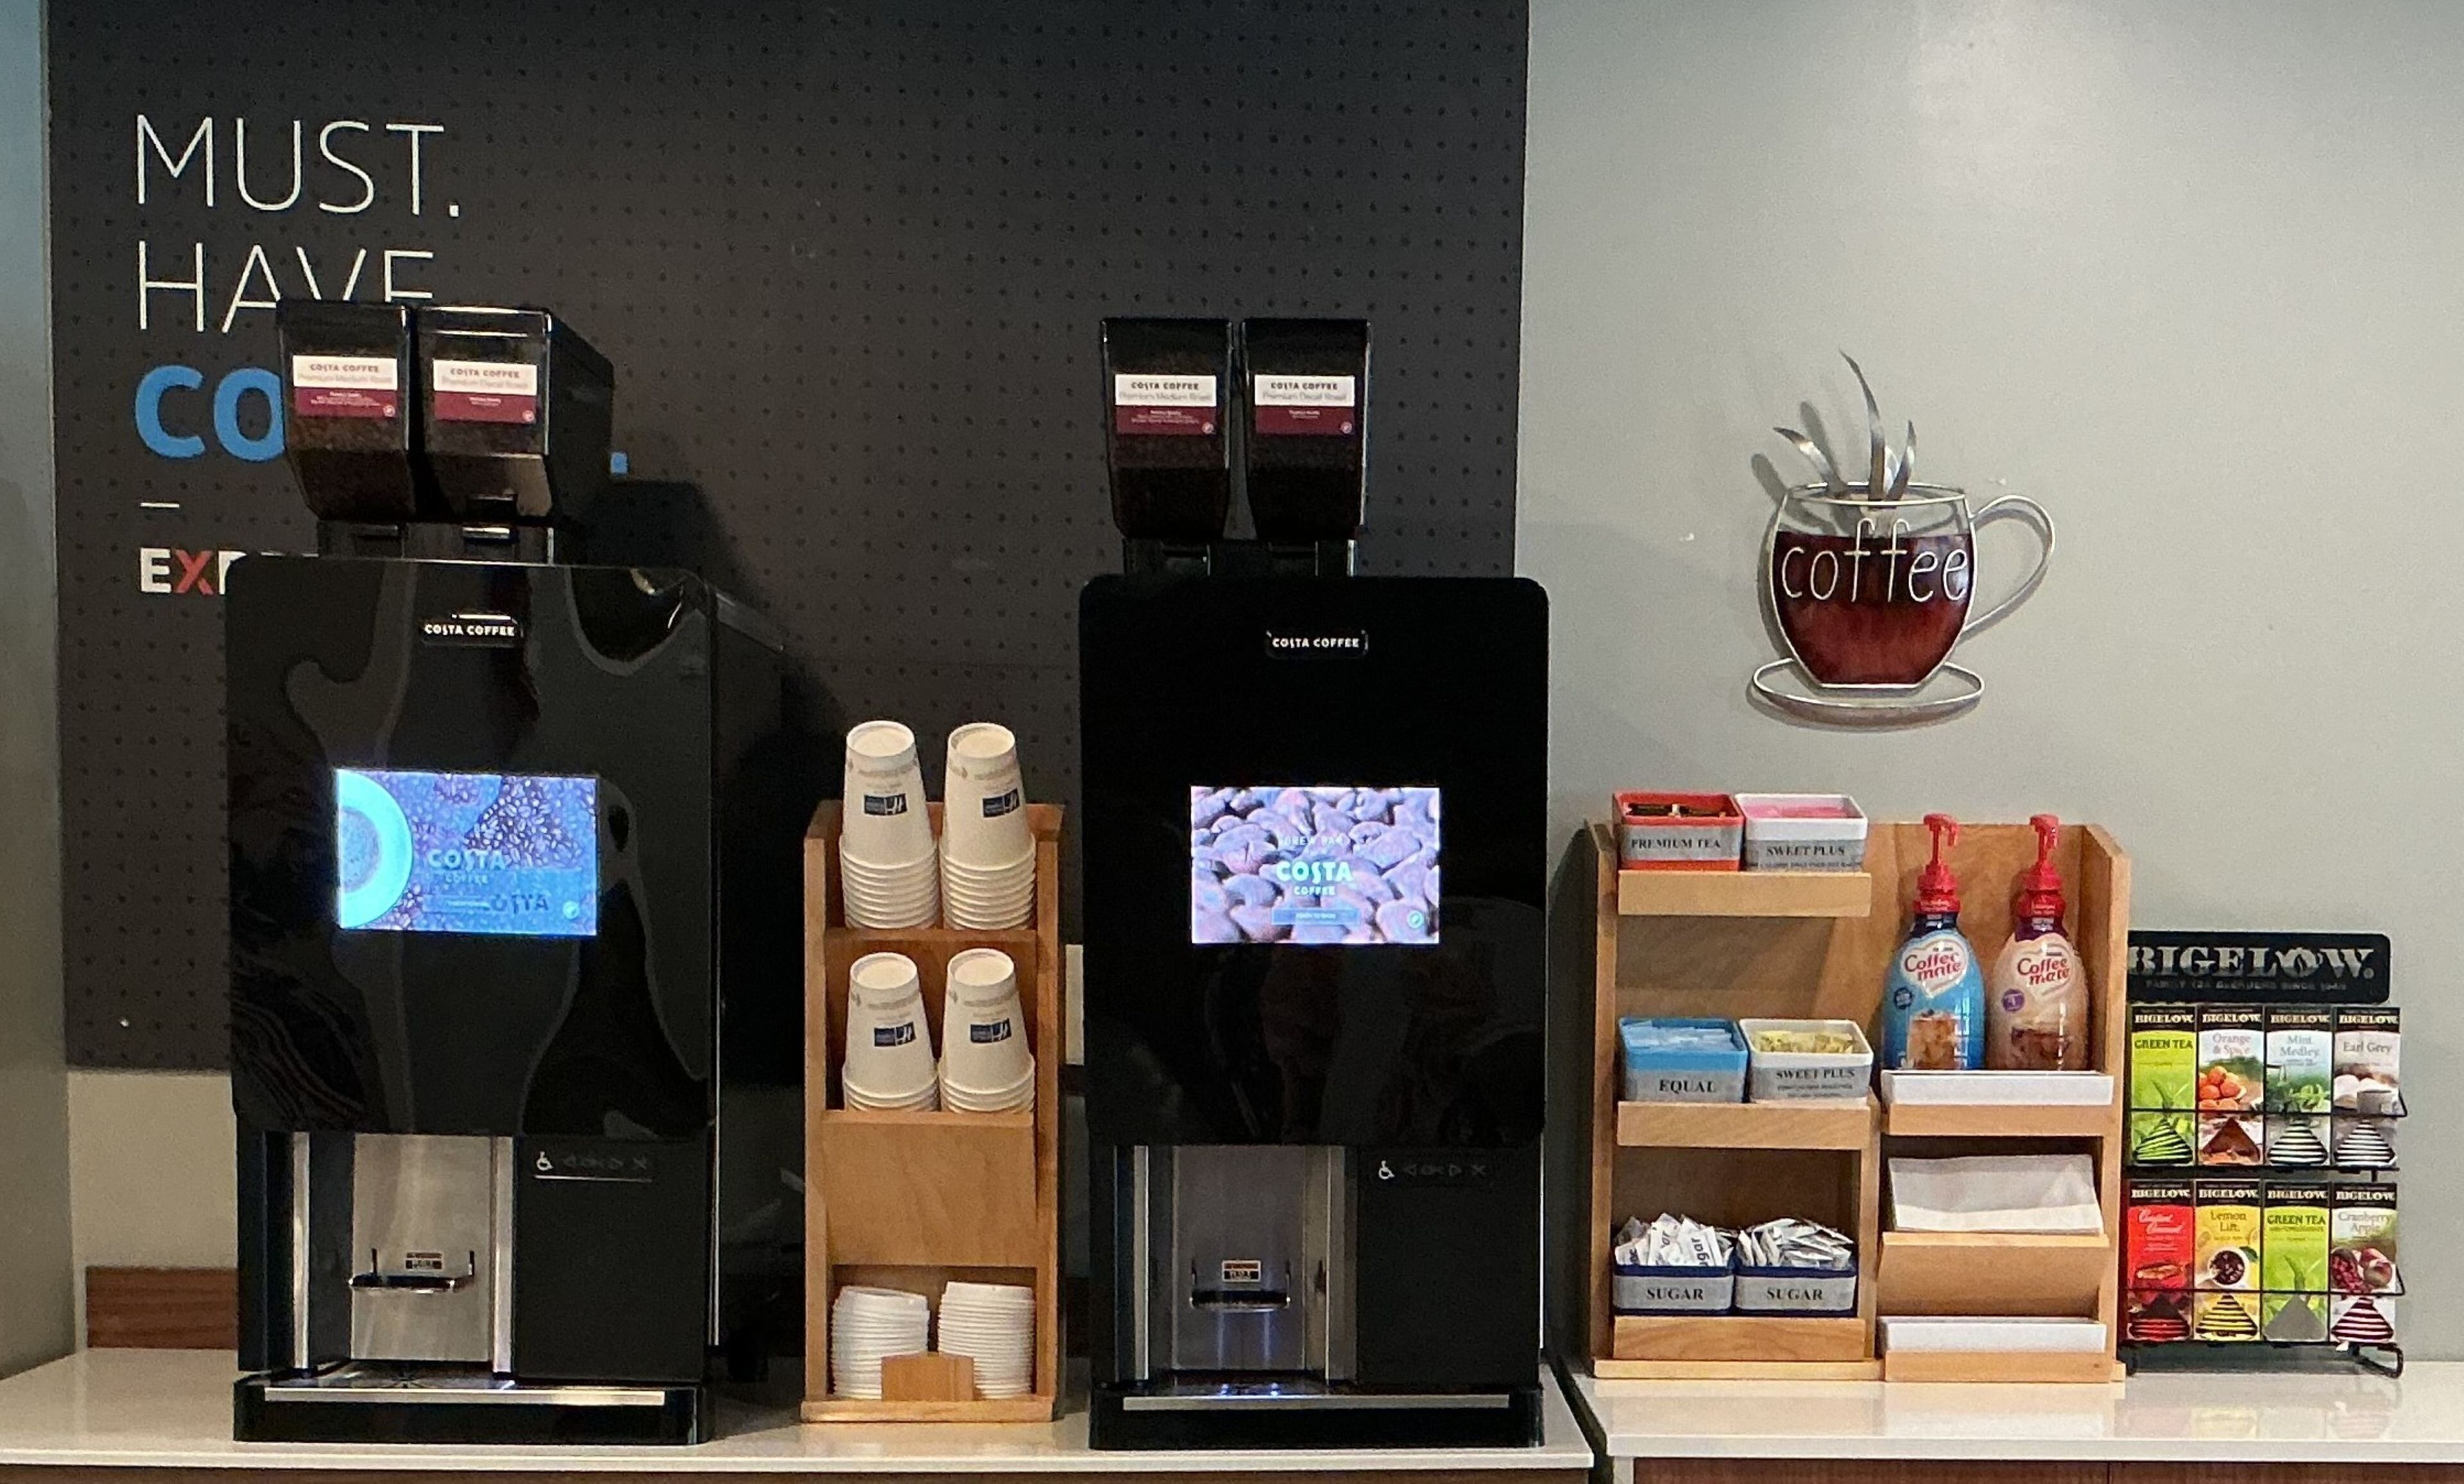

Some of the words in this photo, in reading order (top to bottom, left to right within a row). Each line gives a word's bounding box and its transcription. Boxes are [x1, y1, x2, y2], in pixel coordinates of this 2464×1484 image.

[137, 114, 460, 217] MUST.
[138, 239, 434, 334] HAVE
[310, 363, 340, 372] COSTA
[342, 364, 379, 373] COFFEE
[450, 368, 479, 377] COSTA
[483, 369, 520, 378] COFFEE
[1131, 382, 1159, 391] COSTA
[1163, 382, 1199, 391] COFFEE
[1270, 382, 1300, 391] COSTA
[1781, 518, 1968, 602] coffee
[424, 624, 464, 636] COSTA
[467, 624, 515, 636] COFFEE
[1272, 638, 1310, 649] COSTA
[1313, 638, 1360, 648] COFFEE
[1631, 838, 1692, 849] PREMIUM
[1698, 839, 1721, 848] TEA
[1767, 846, 1811, 856] SWEET
[1813, 846, 1845, 856] PLUS
[428, 848, 506, 872] COSTA
[1276, 861, 1353, 884] COSTA
[1294, 886, 1335, 895] COFFEE
[1904, 953, 1959, 973] Coffee
[2017, 958, 2068, 976] Coffee
[1917, 962, 1962, 982] mate
[2030, 967, 2070, 985] mate
[2134, 1039, 2171, 1050] GREEN
[2171, 1039, 2193, 1050] TEA
[2212, 1033, 2252, 1046] Orange
[2288, 1035, 2311, 1045] Mint
[2280, 1045, 2320, 1057] Medley
[2343, 1041, 2364, 1052] Earl
[2367, 1042, 2392, 1054] Grey
[1776, 1069, 1818, 1079] SWEET
[1824, 1069, 1855, 1078] PLUS
[1659, 1079, 1716, 1093] EQUAL
[2211, 1210, 2246, 1220] Lemon
[2267, 1215, 2303, 1225] GREEN
[2306, 1215, 2326, 1225] TEA
[1646, 1288, 1704, 1300] SUGAR
[1767, 1288, 1823, 1301] SUGAR
